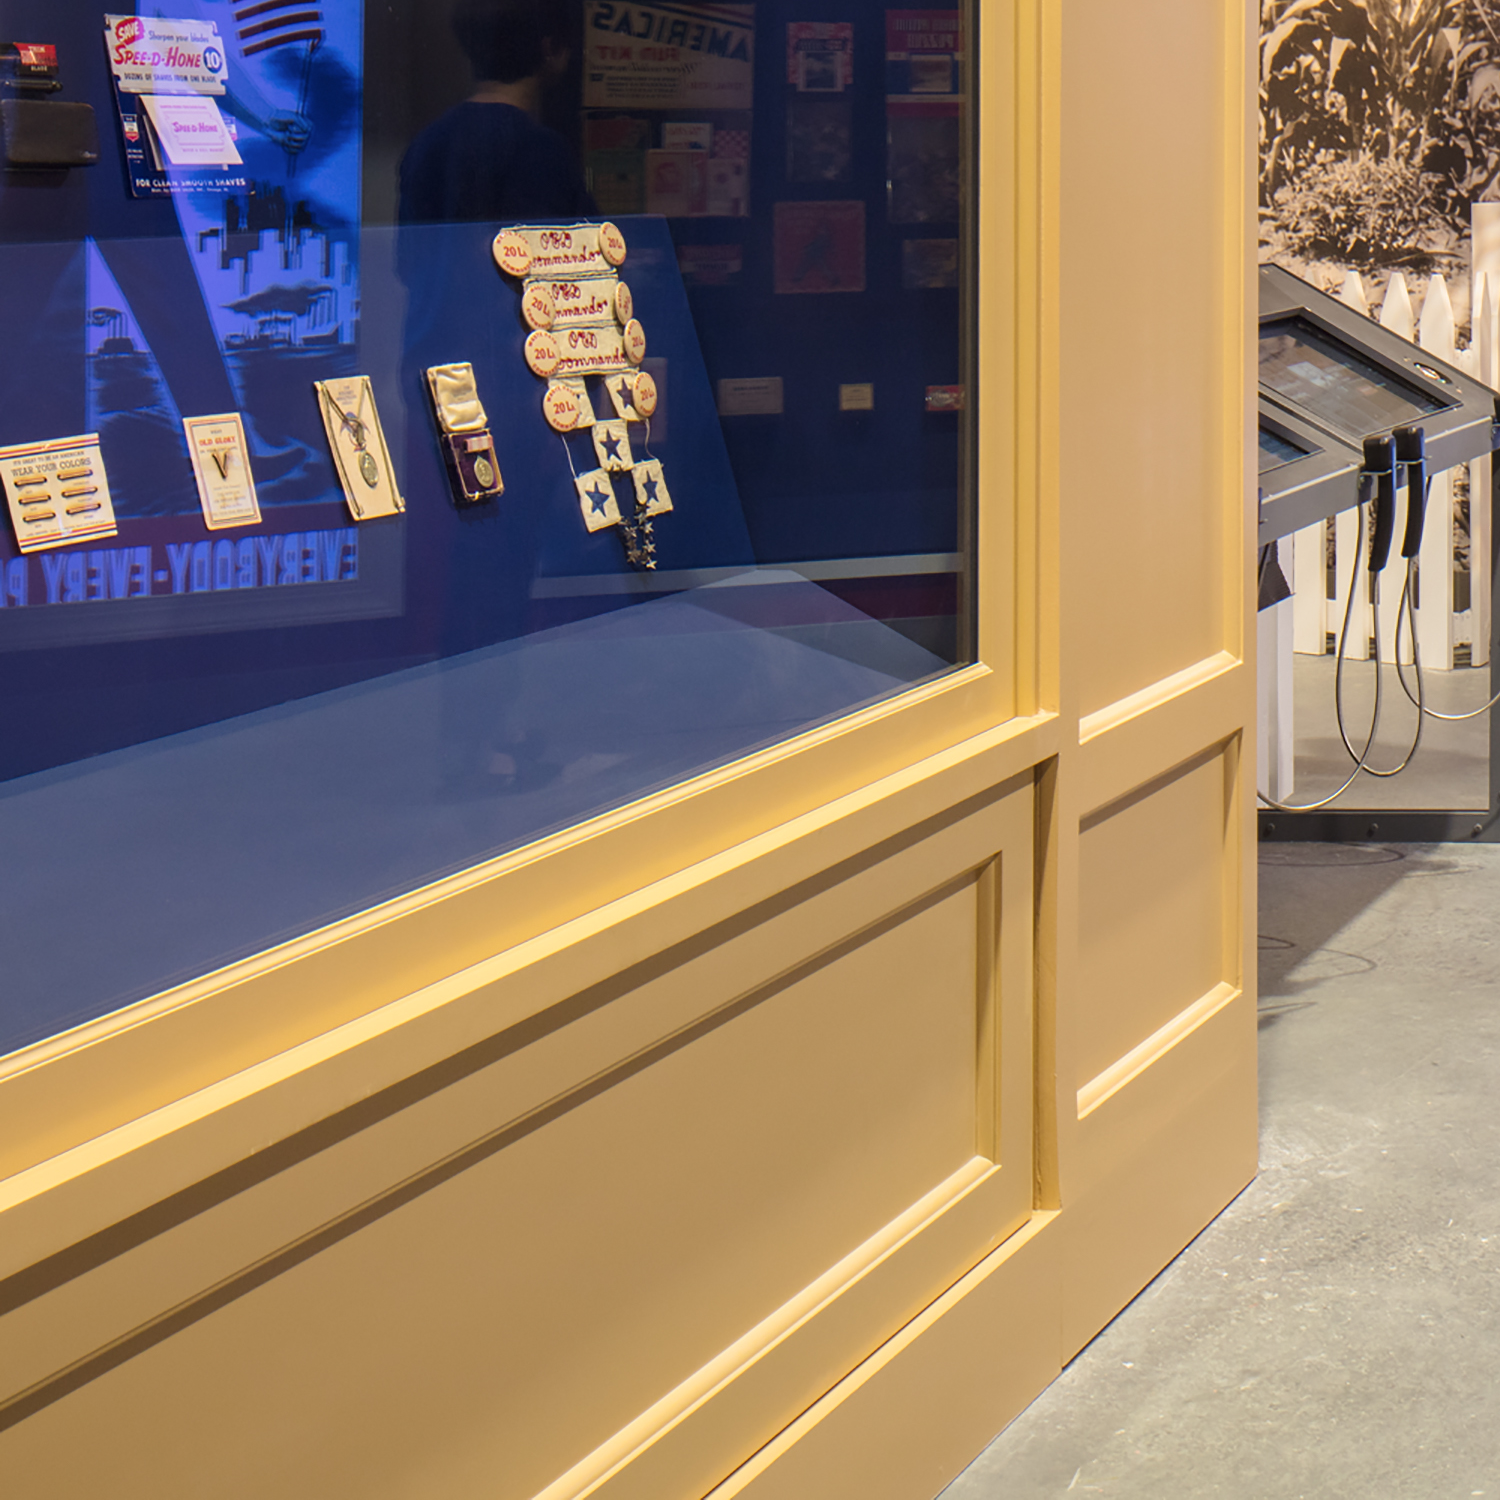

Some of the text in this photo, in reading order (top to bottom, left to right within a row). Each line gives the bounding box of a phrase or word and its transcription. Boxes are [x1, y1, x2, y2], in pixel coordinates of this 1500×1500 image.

[119, 20, 141, 43] SAVE
[11, 457, 91, 477] WEAR YOUR COLORS
